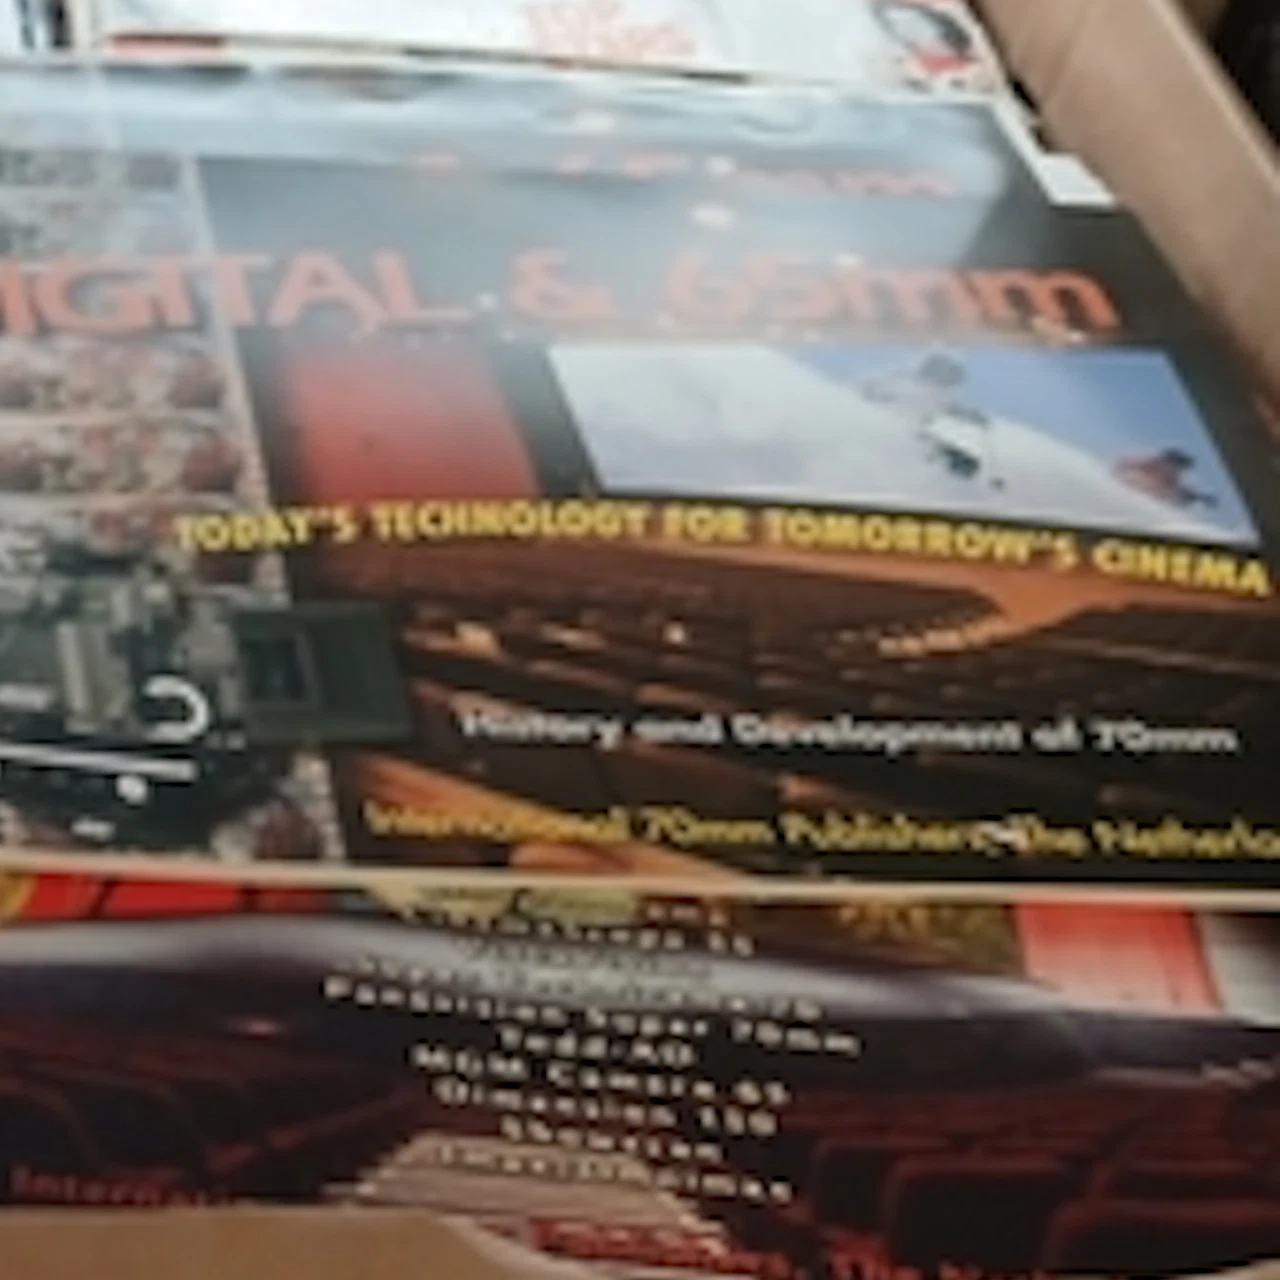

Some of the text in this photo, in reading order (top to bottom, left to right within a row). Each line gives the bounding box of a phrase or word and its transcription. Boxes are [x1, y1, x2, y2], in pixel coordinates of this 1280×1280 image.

[508, 246, 618, 325] &
[665, 250, 1123, 330] 65mm
[174, 497, 1272, 599] TODAY'S TECHNOLOGY FOR TOMORROW'S CINEMA
[460, 712, 623, 752] History
[632, 712, 724, 745] and
[732, 713, 1023, 761] Development
[1090, 716, 1238, 754] 70mm
[363, 800, 629, 844] International
[642, 806, 774, 847] 70mm
